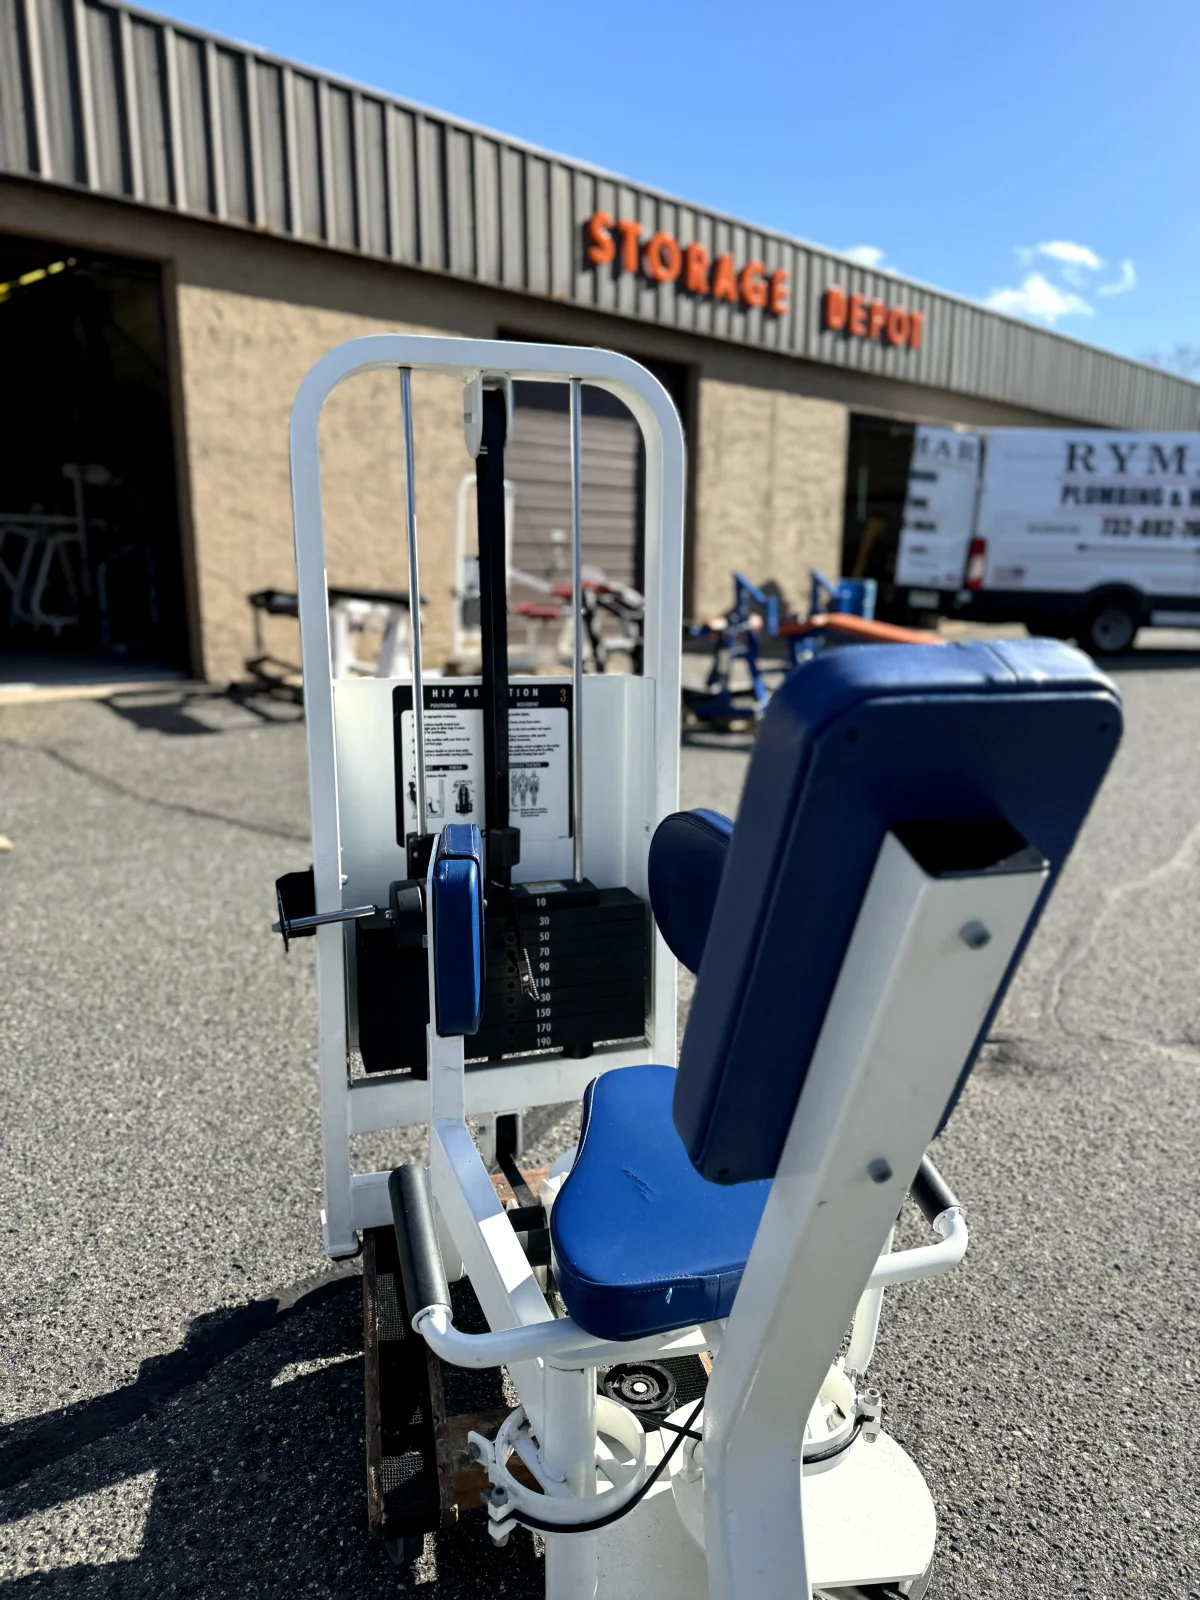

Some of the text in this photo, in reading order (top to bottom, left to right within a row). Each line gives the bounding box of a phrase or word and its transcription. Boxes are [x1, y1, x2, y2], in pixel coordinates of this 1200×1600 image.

[587, 211, 924, 350] STORAGE DEPOT
[1066, 441, 1200, 475] RYM
[431, 688, 455, 698] HIP
[559, 688, 567, 703] 3
[536, 897, 547, 907] 10
[539, 916, 550, 926] 30
[539, 932, 550, 941] 50
[539, 947, 550, 957] 70
[539, 962, 550, 971] 90
[535, 977, 550, 987] 110
[539, 993, 551, 1002] 30
[536, 1008, 551, 1018] 150
[536, 1023, 552, 1033] 170
[536, 1037, 552, 1047] 190
